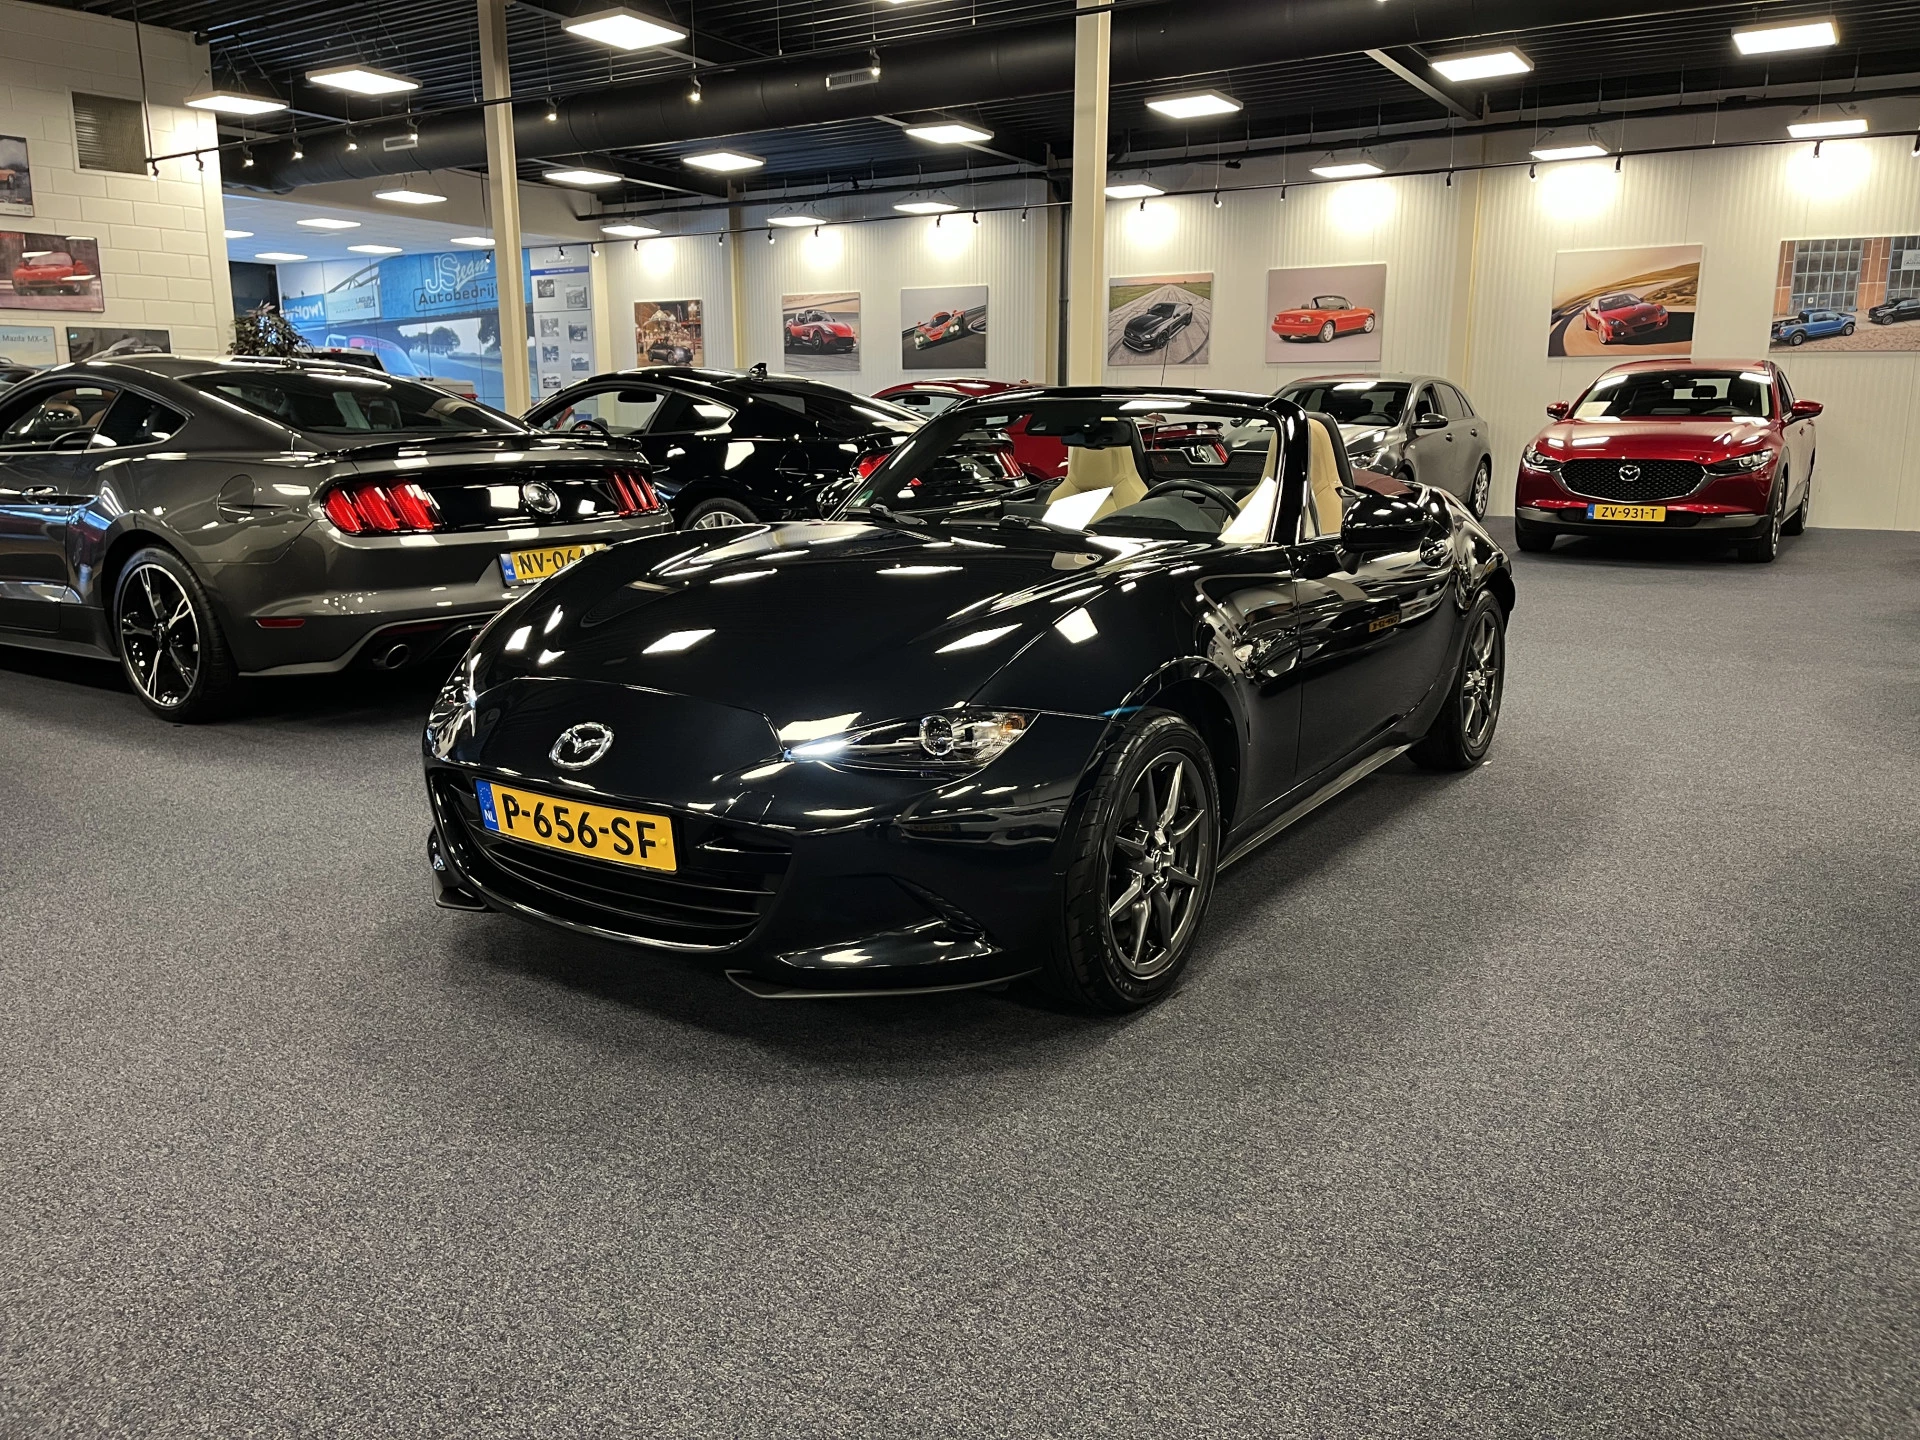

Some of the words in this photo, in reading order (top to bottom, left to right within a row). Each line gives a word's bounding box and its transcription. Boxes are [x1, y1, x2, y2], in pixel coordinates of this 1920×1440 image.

[419, 283, 498, 305] Autobedrij
[1601, 507, 1658, 519] ZV-931-T
[484, 809, 496, 823] NL
[501, 793, 656, 859] P-656-SF
